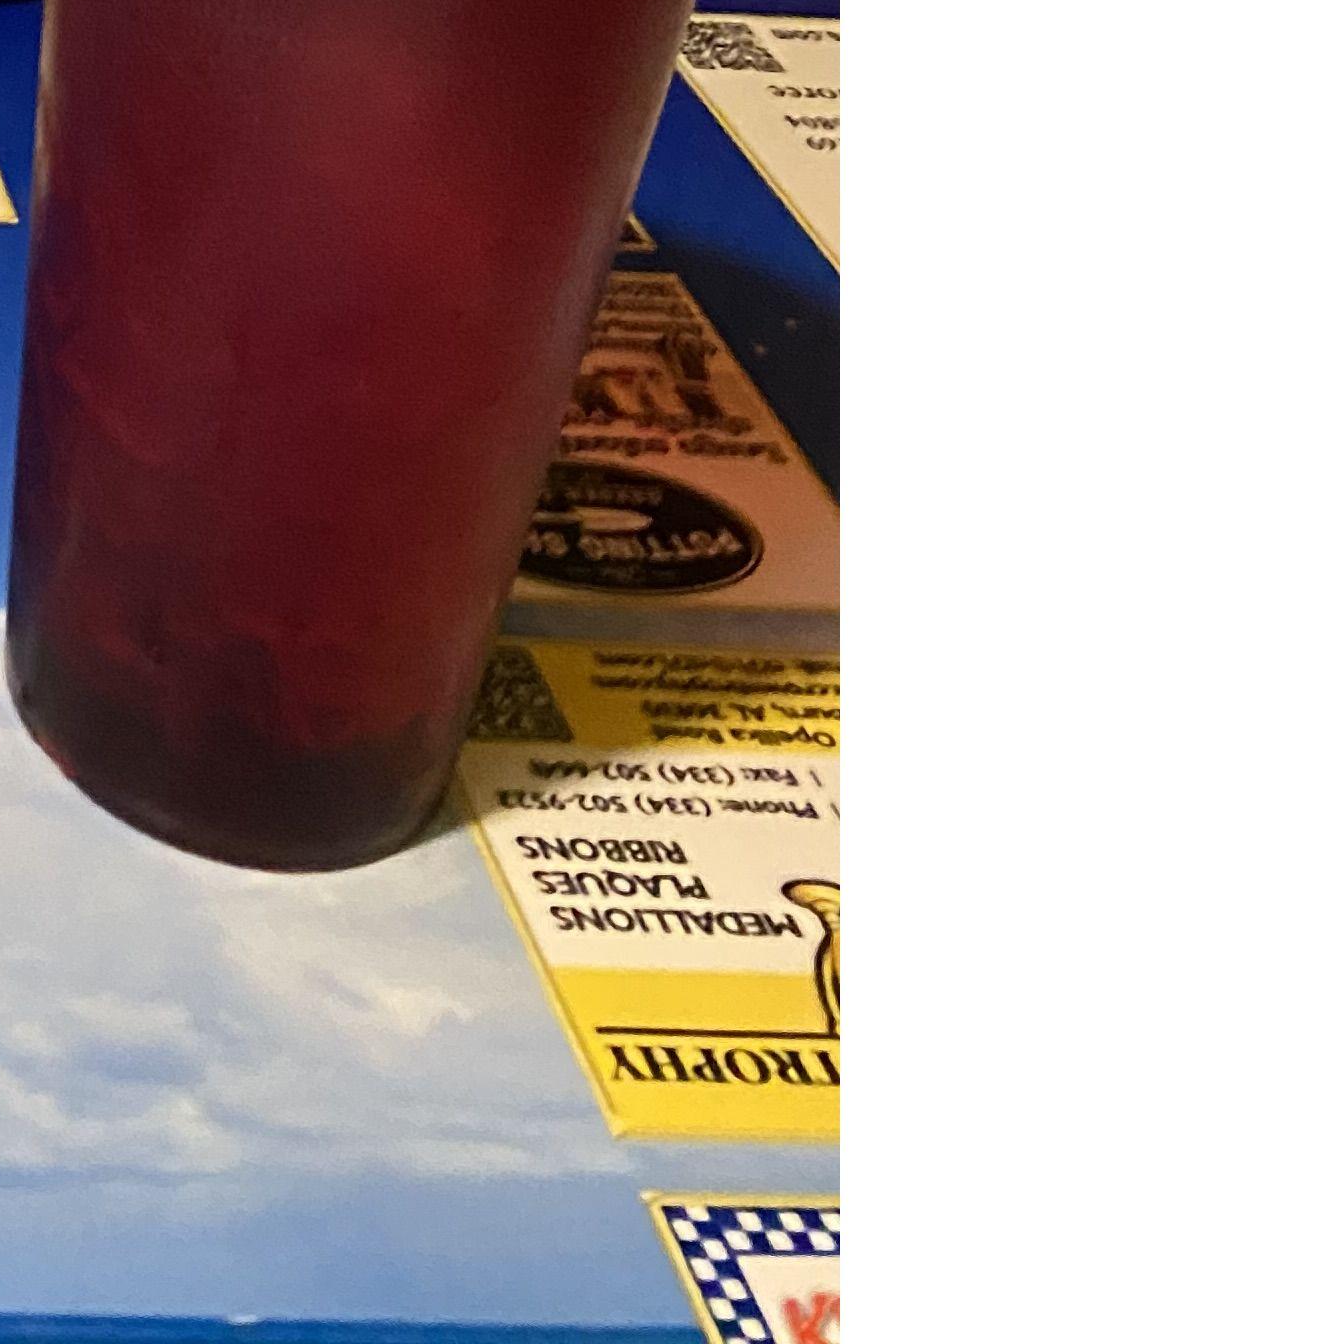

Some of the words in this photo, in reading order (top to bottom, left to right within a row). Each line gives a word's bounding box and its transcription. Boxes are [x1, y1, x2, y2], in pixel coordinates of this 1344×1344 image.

[657, 762, 734, 787] (334)
[741, 767, 798, 787] Fax:
[634, 793, 711, 818] (334)
[717, 798, 819, 820] Phone:
[515, 835, 688, 866] RIBBONS
[532, 869, 712, 902] PLAQUES
[549, 905, 803, 939] MEDALLIONS
[608, 1045, 840, 1087] TROPHY
